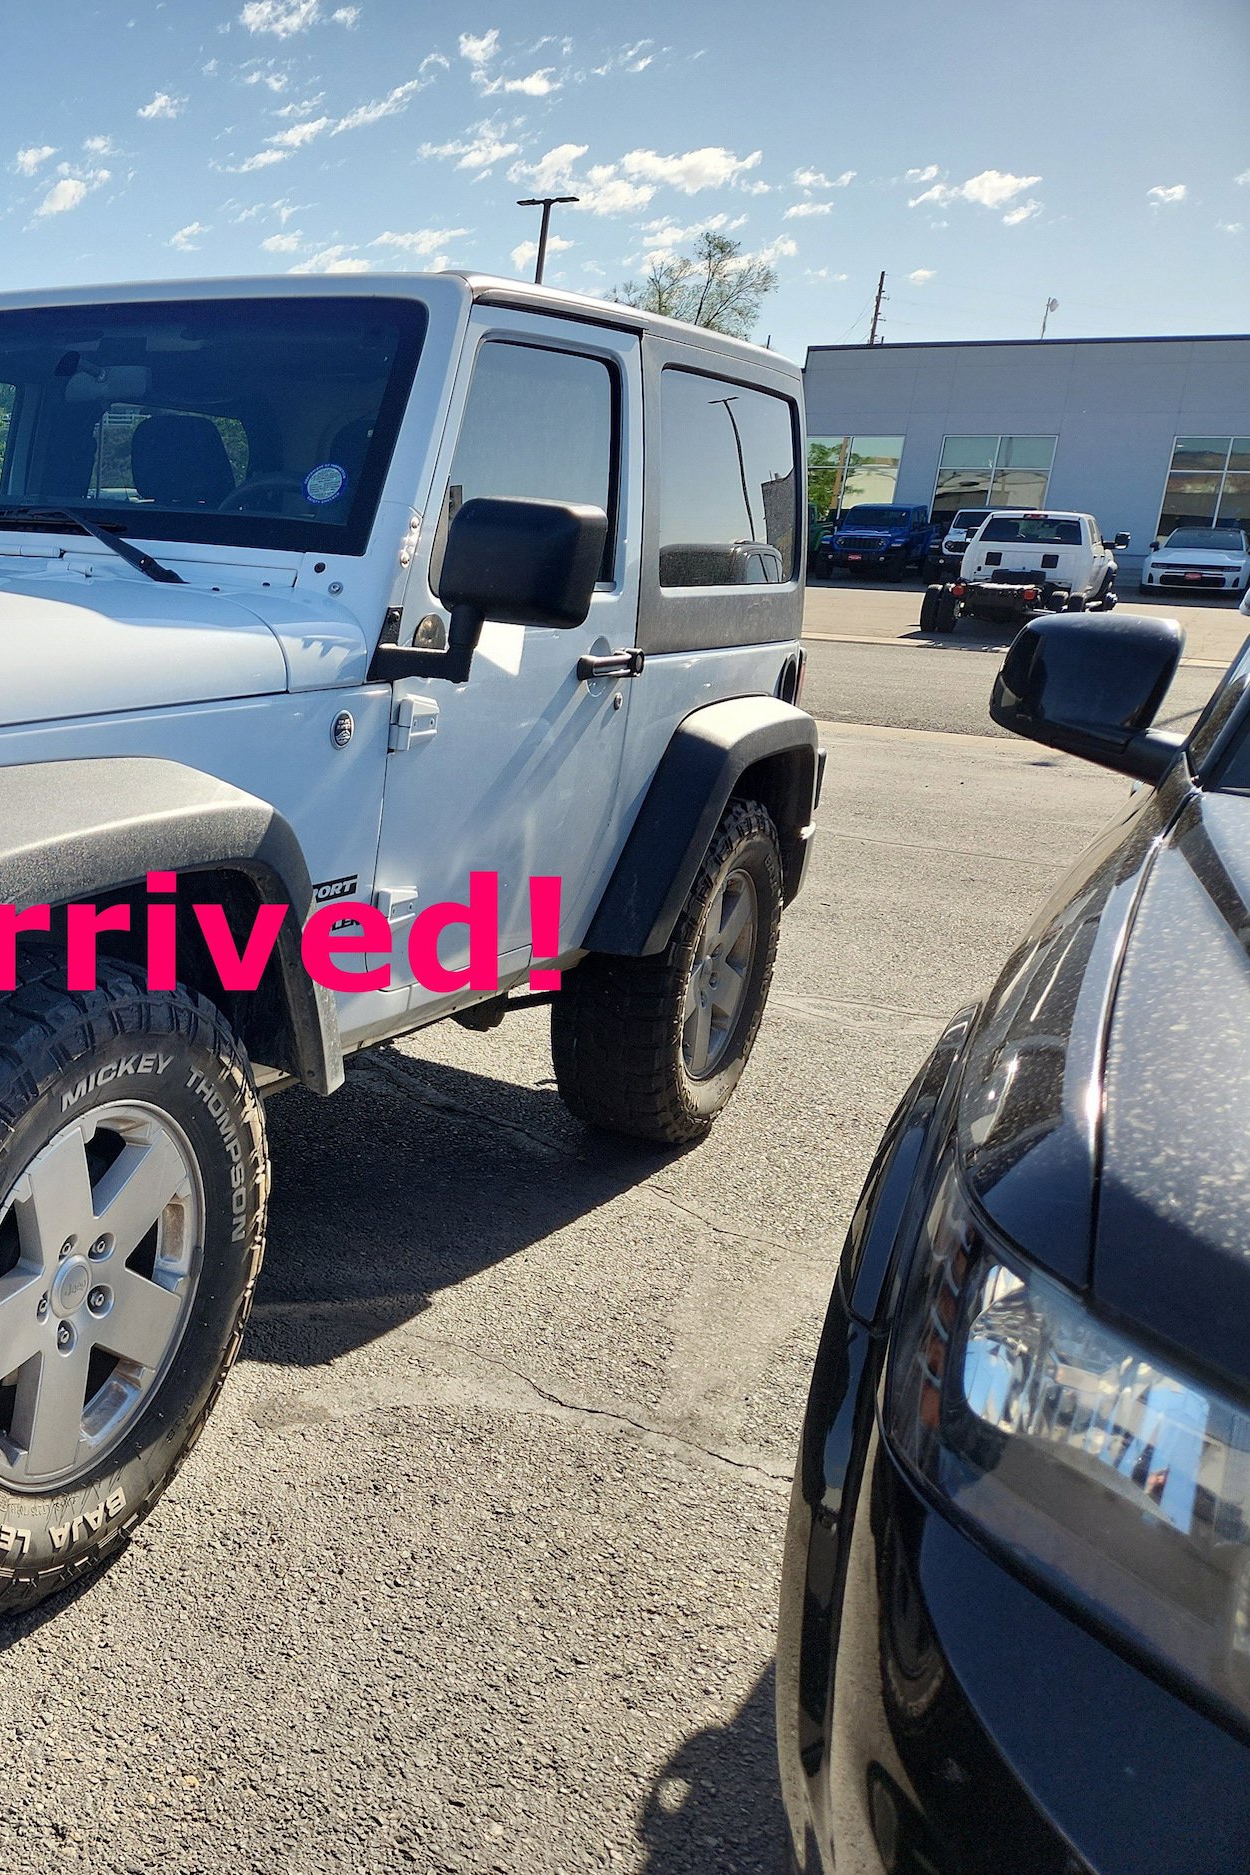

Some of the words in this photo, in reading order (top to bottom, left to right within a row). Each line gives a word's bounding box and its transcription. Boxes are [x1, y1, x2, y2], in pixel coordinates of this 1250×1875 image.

[313, 880, 358, 899] PORT
[60, 1053, 174, 1113] MICKEY
[186, 1065, 247, 1242] THOMPSON
[49, 1486, 127, 1549] BAJA
